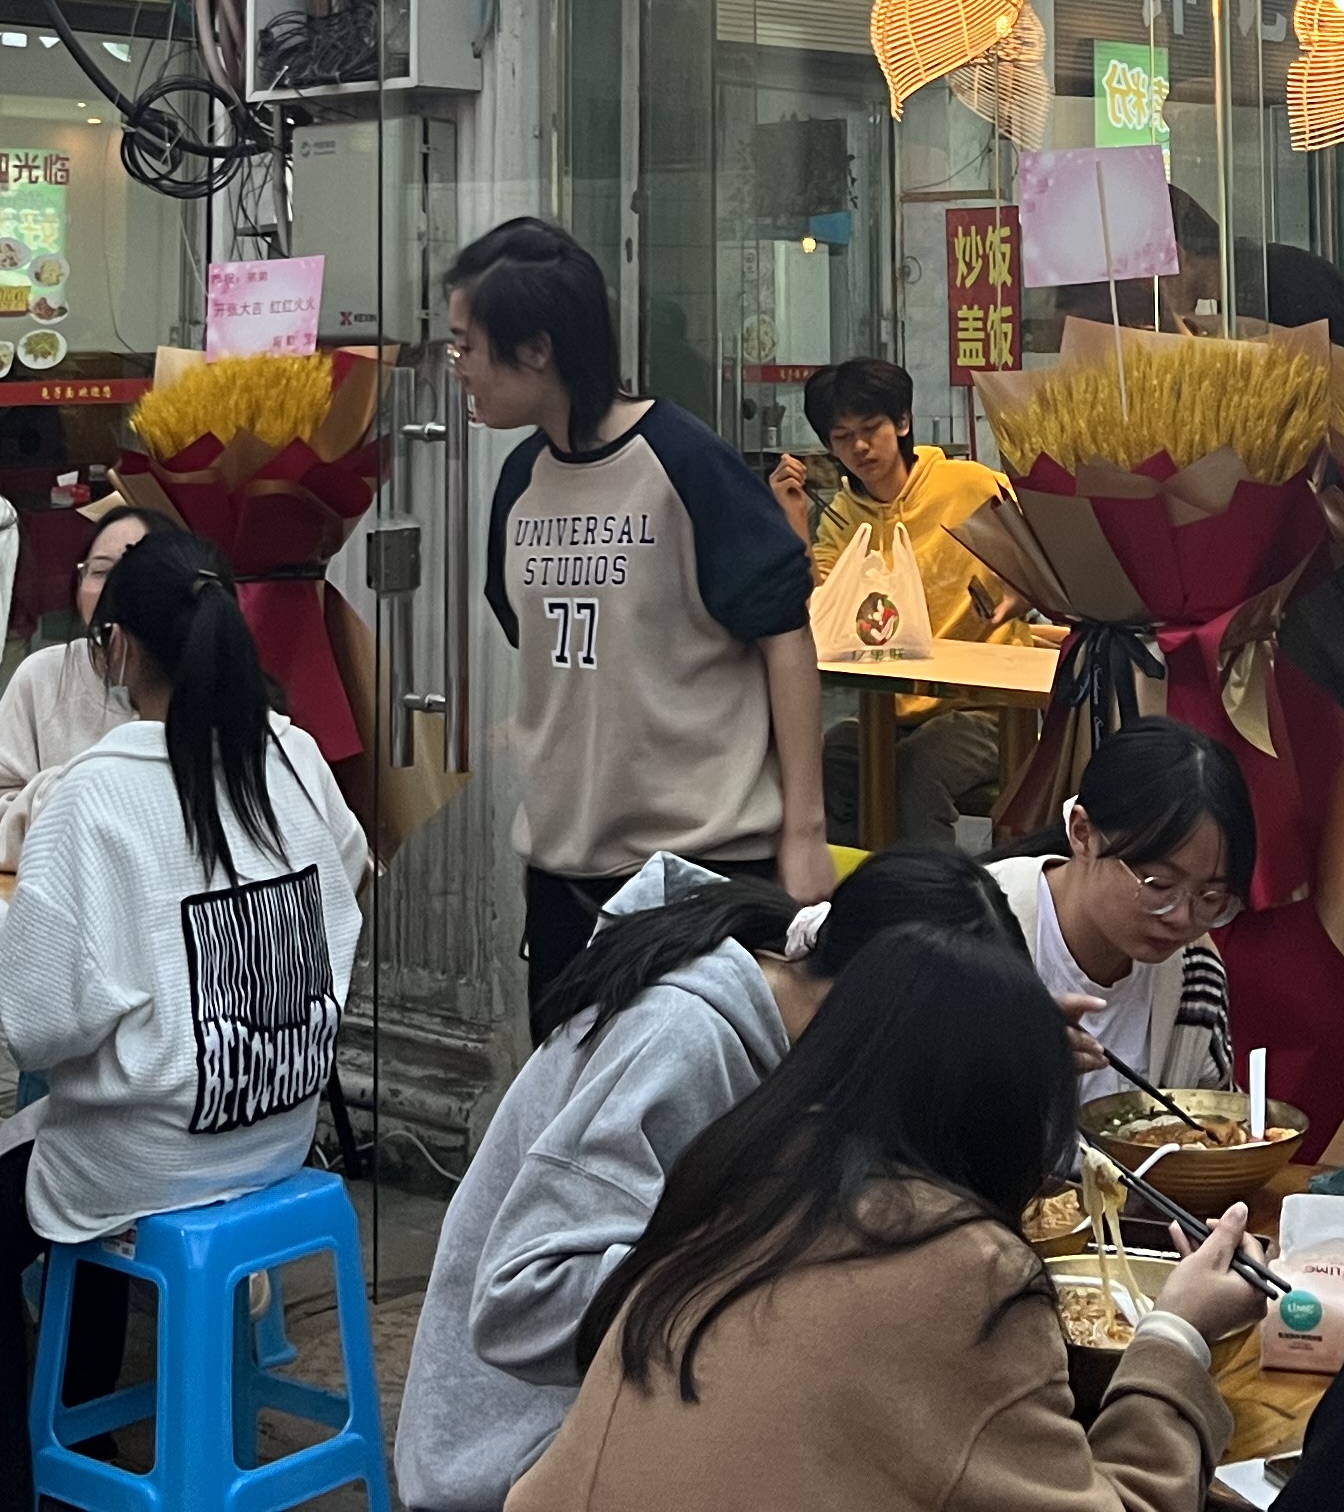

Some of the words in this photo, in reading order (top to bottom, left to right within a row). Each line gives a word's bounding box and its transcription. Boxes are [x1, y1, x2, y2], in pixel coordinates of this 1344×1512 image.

[954, 225, 1013, 289] 炒饭
[957, 304, 1014, 368] 盖饭
[514, 513, 657, 548] UNIVERSAL
[522, 554, 630, 587] STUDIOS
[542, 595, 601, 671] 77
